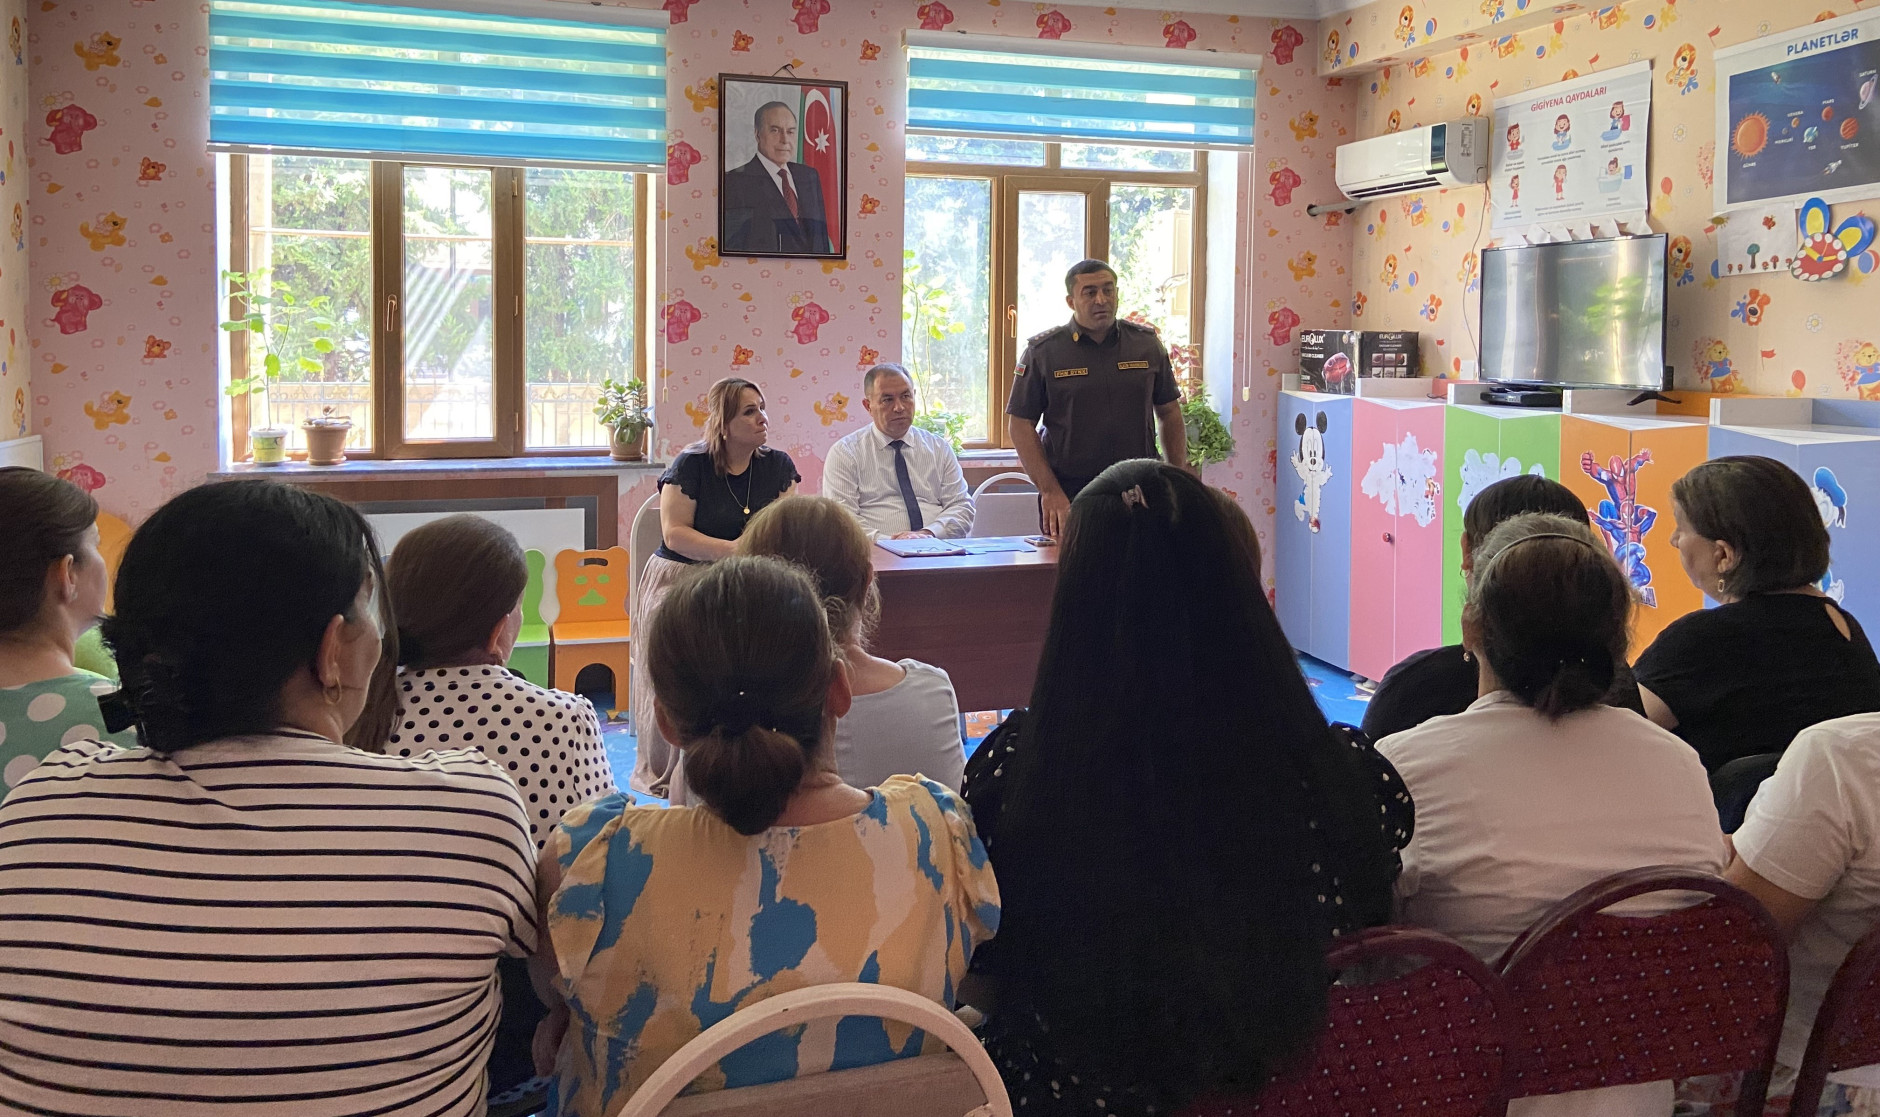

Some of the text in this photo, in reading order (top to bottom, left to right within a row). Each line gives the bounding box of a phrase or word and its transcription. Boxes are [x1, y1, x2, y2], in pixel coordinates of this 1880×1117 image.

[1787, 28, 1859, 56] PLANETLƏR
[1530, 86, 1607, 112] GİGİYENA QAYDALARI
